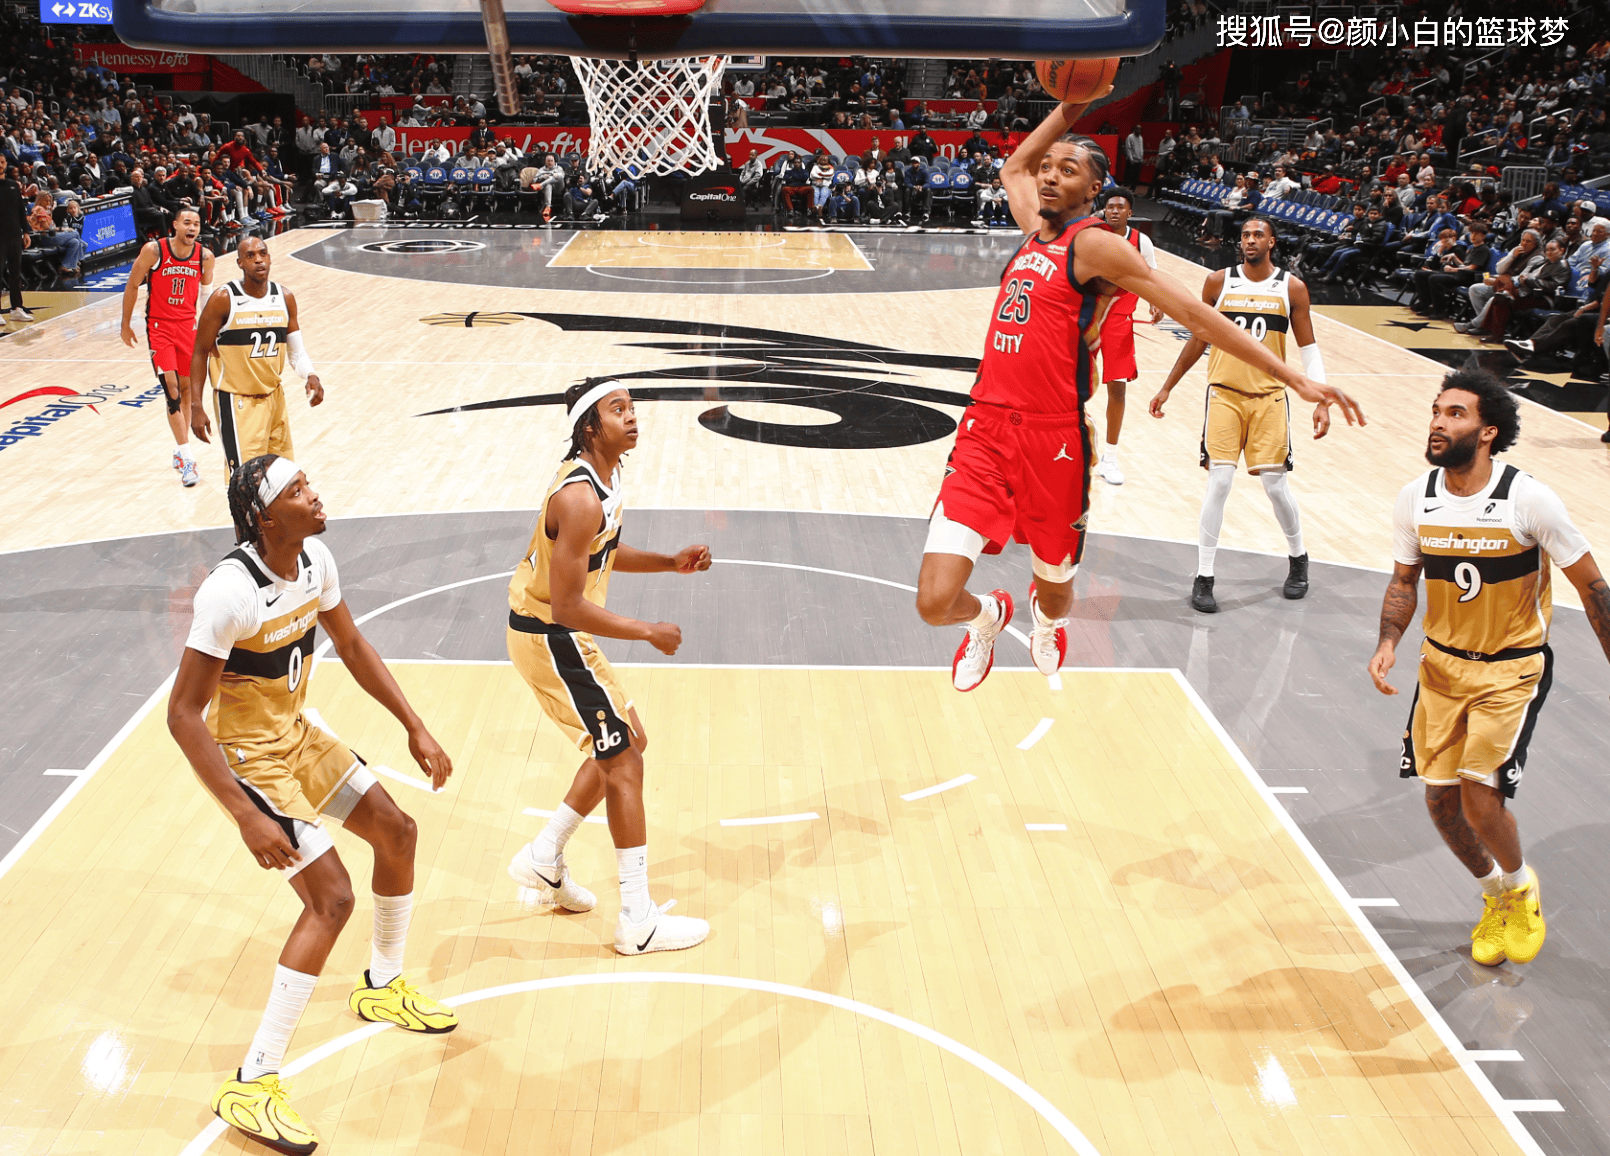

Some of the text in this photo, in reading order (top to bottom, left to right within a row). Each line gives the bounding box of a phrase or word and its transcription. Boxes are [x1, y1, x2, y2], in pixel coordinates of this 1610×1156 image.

[95, 51, 190, 68] Hennessy Lofts
[162, 265, 198, 278] CRESCENT
[1008, 250, 1059, 282] ESCENT
[171, 278, 186, 296] 11
[168, 297, 185, 306] CITY
[997, 277, 1035, 325] 25
[1223, 295, 1281, 311] washington
[235, 313, 284, 326] washington
[249, 331, 280, 359] 22
[993, 330, 1024, 354] CITY
[1419, 532, 1510, 555] washington
[1454, 560, 1483, 604] 9
[264, 607, 318, 645] washington
[287, 645, 303, 694] 0
